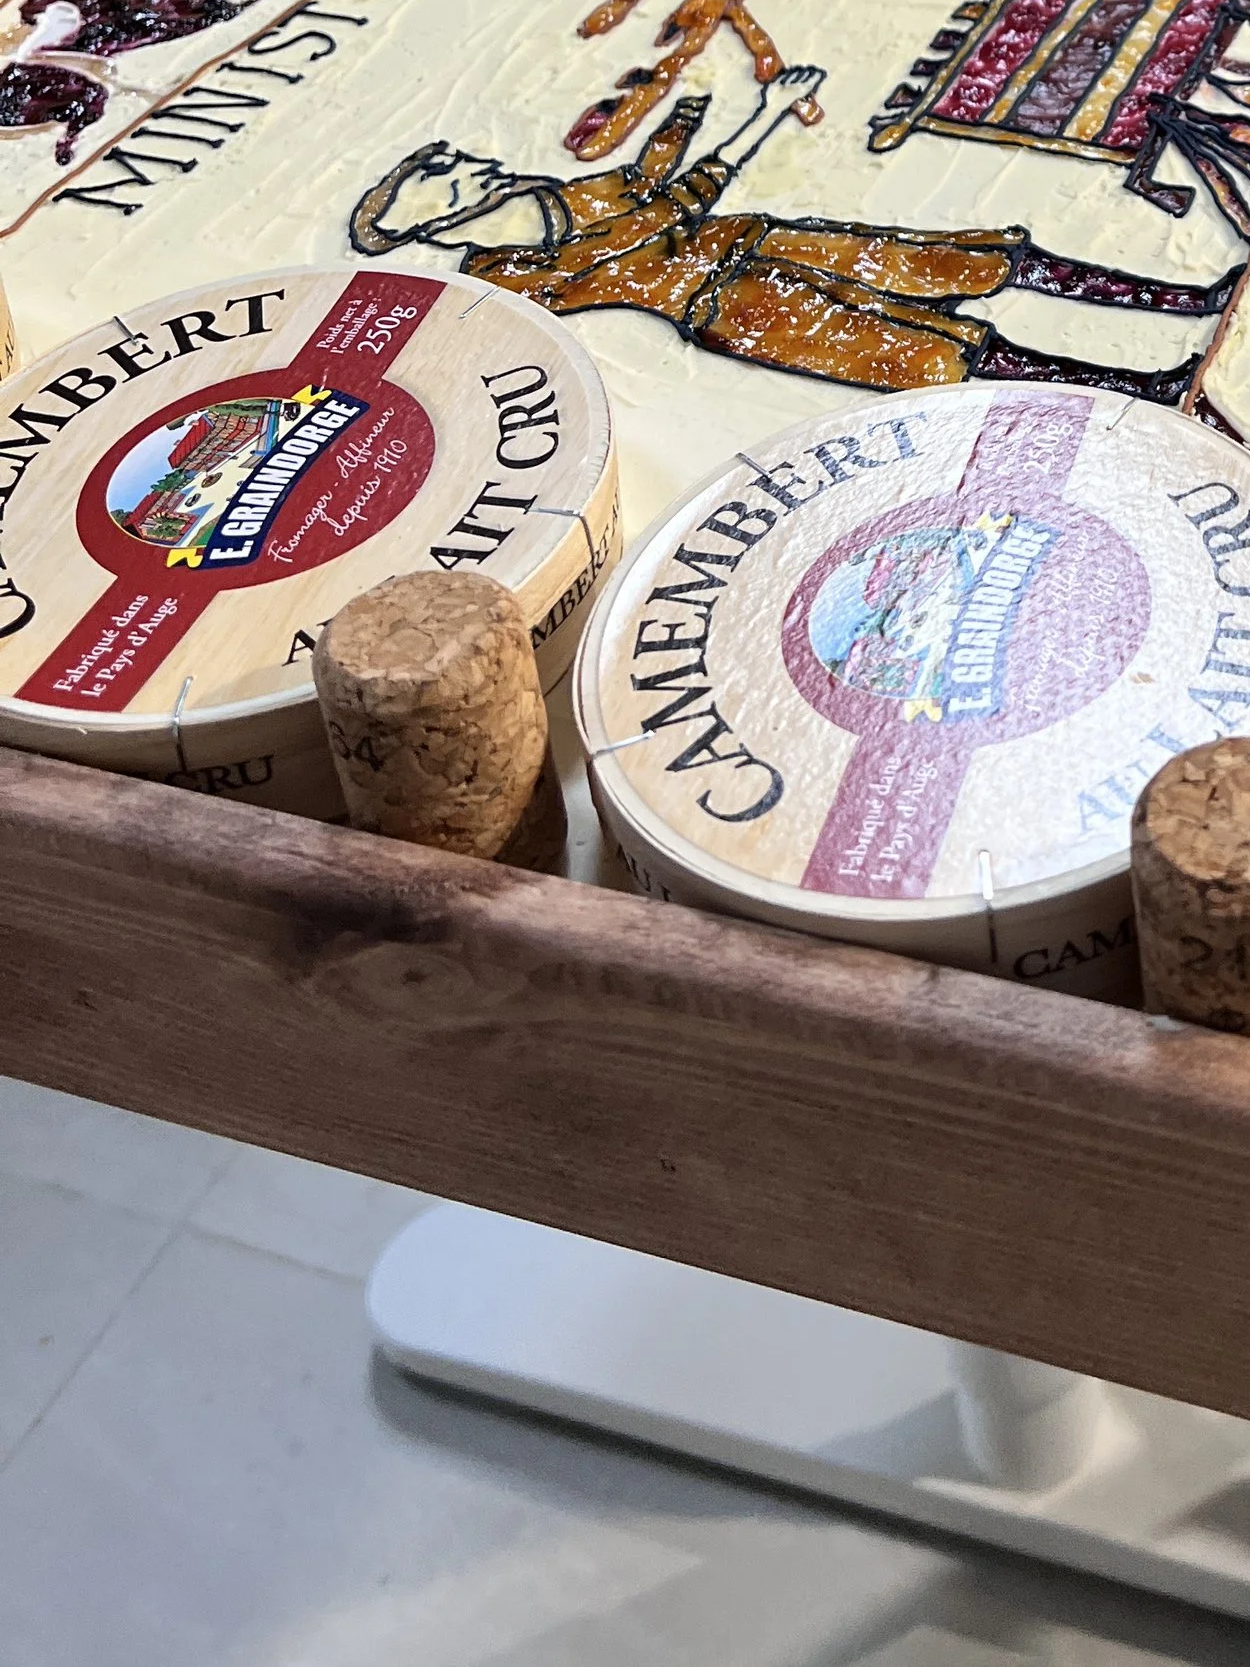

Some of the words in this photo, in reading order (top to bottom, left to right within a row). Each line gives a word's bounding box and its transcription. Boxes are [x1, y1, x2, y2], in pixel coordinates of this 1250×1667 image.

[316, 319, 345, 350] Poids
[340, 304, 358, 325] net
[356, 304, 418, 356] 250g
[480, 364, 561, 470] CRU
[1022, 422, 1075, 474] 250g
[220, 398, 361, 537] GRAINDORGE
[267, 489, 333, 564] Fromager
[338, 406, 396, 479] Affineur
[327, 474, 382, 537] depuis
[373, 438, 409, 474] 1910
[208, 539, 254, 561] E.
[430, 480, 538, 571] AIT
[53, 627, 120, 693] Fabriqué
[111, 594, 149, 628] dans
[80, 682, 107, 698] le
[96, 647, 136, 682] Pays
[127, 596, 179, 647] d'Auge
[629, 410, 928, 824] CAMEMBERT
[953, 522, 1052, 686] GRAINDORGE
